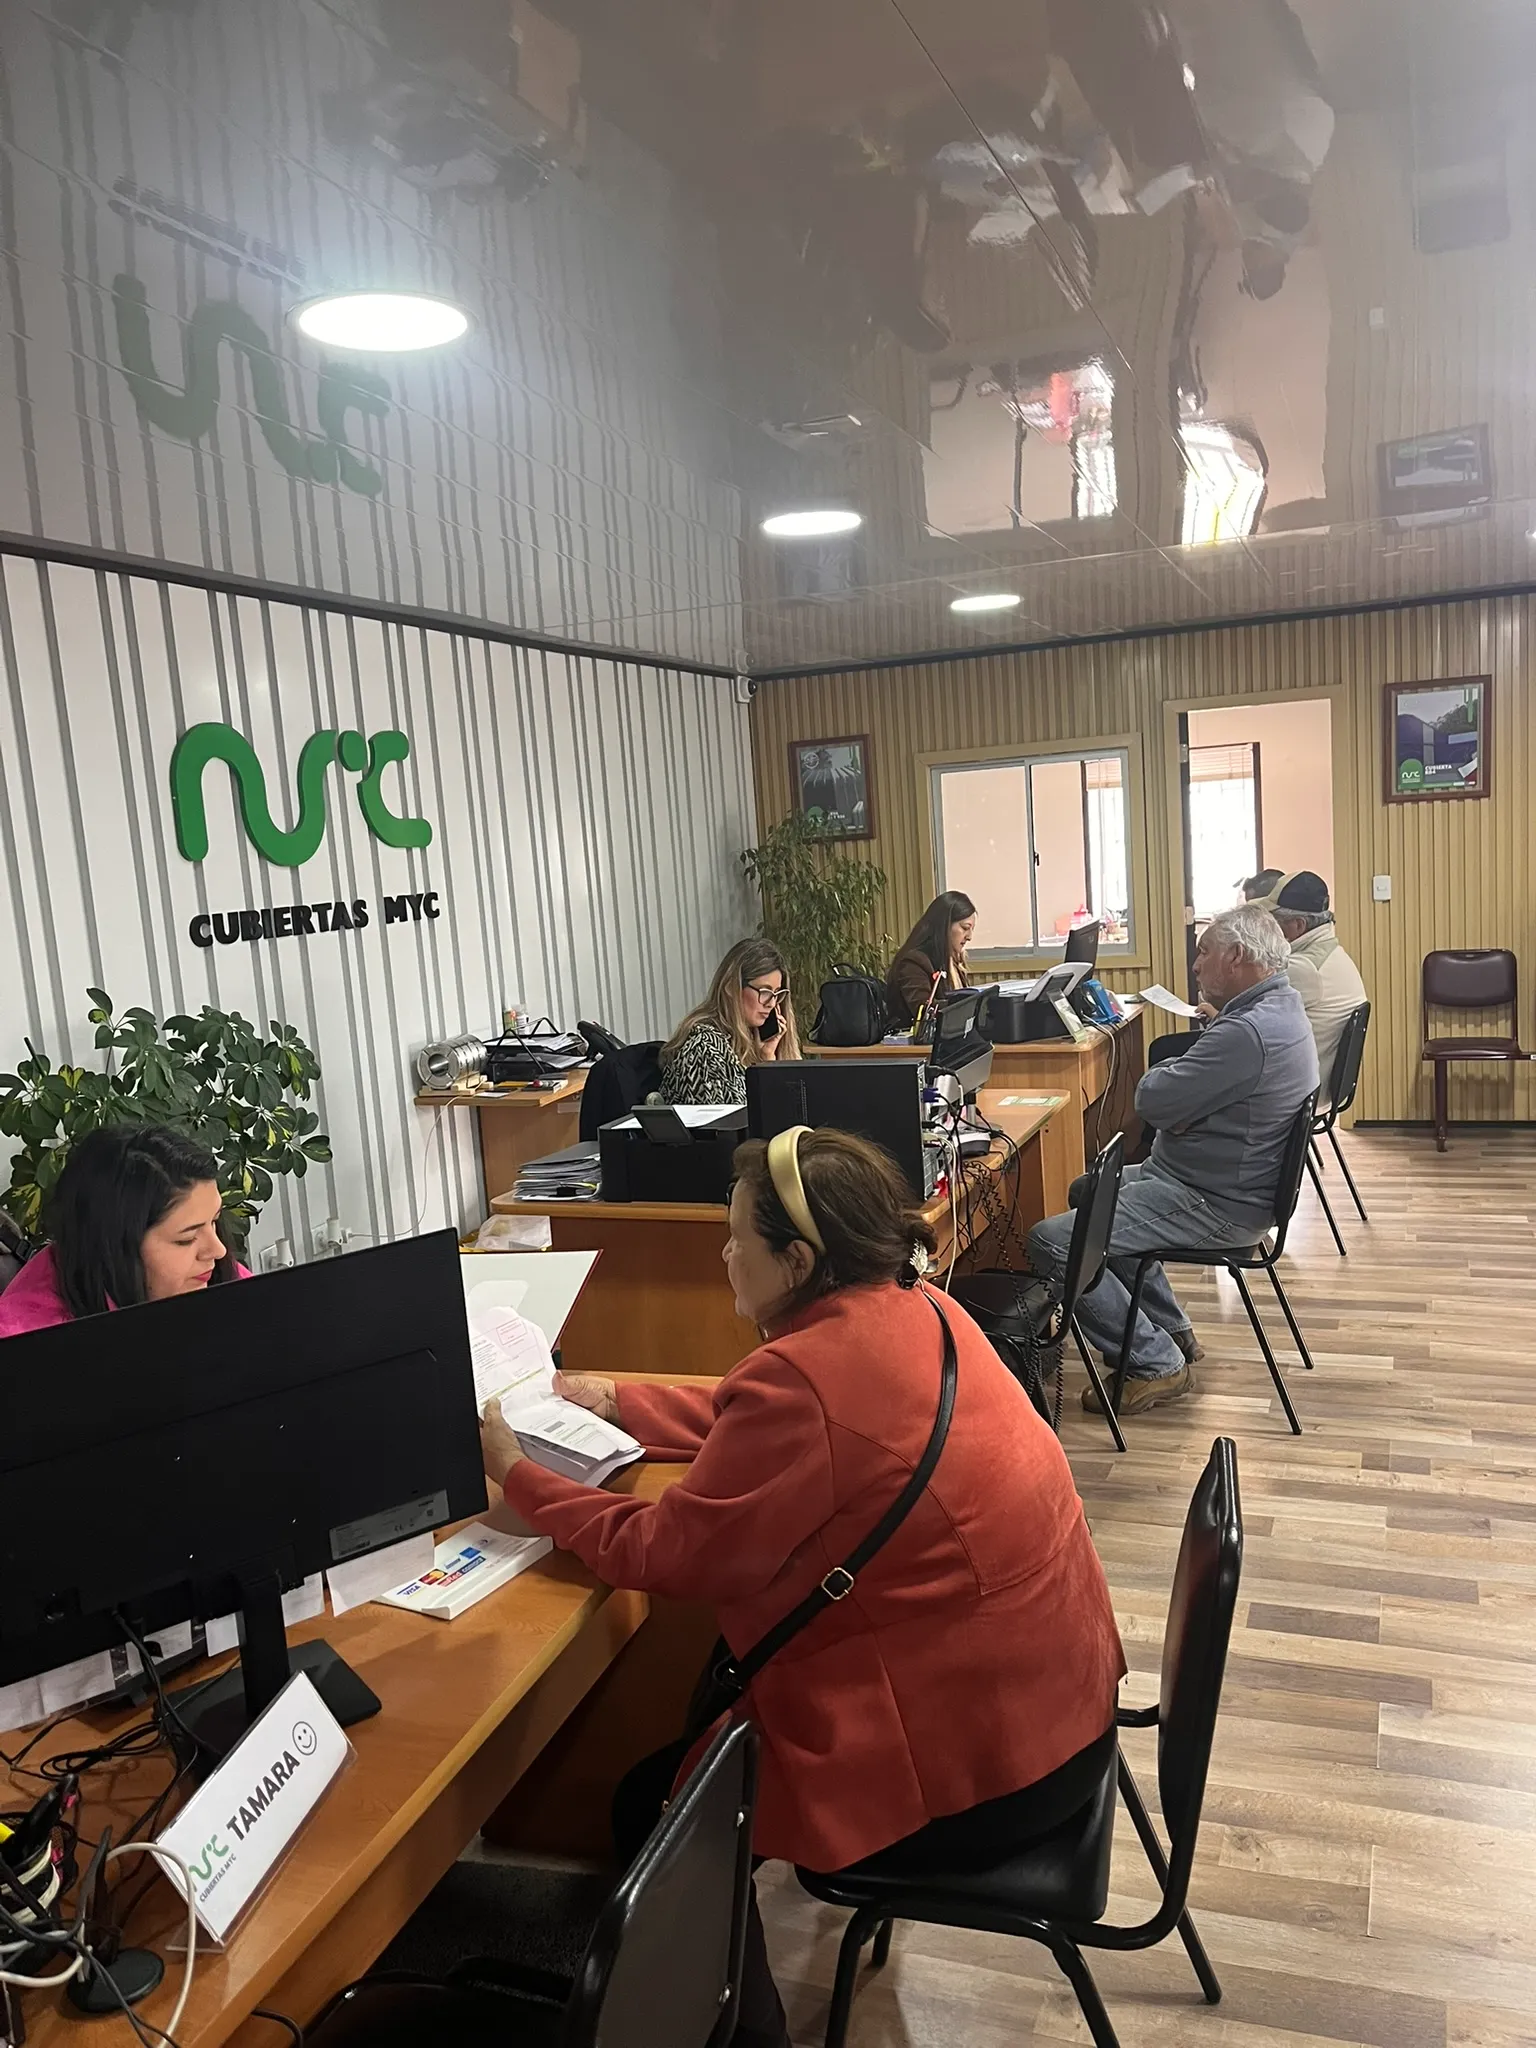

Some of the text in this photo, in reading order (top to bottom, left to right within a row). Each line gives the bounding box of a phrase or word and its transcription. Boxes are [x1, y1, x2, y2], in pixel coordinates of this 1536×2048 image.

[189, 892, 440, 948] CUBIERTAS MYC
[403, 1585, 420, 1595] VISA
[226, 1750, 301, 1842] TAMARA
[198, 1853, 237, 1903] CUBIERTAS MYC
